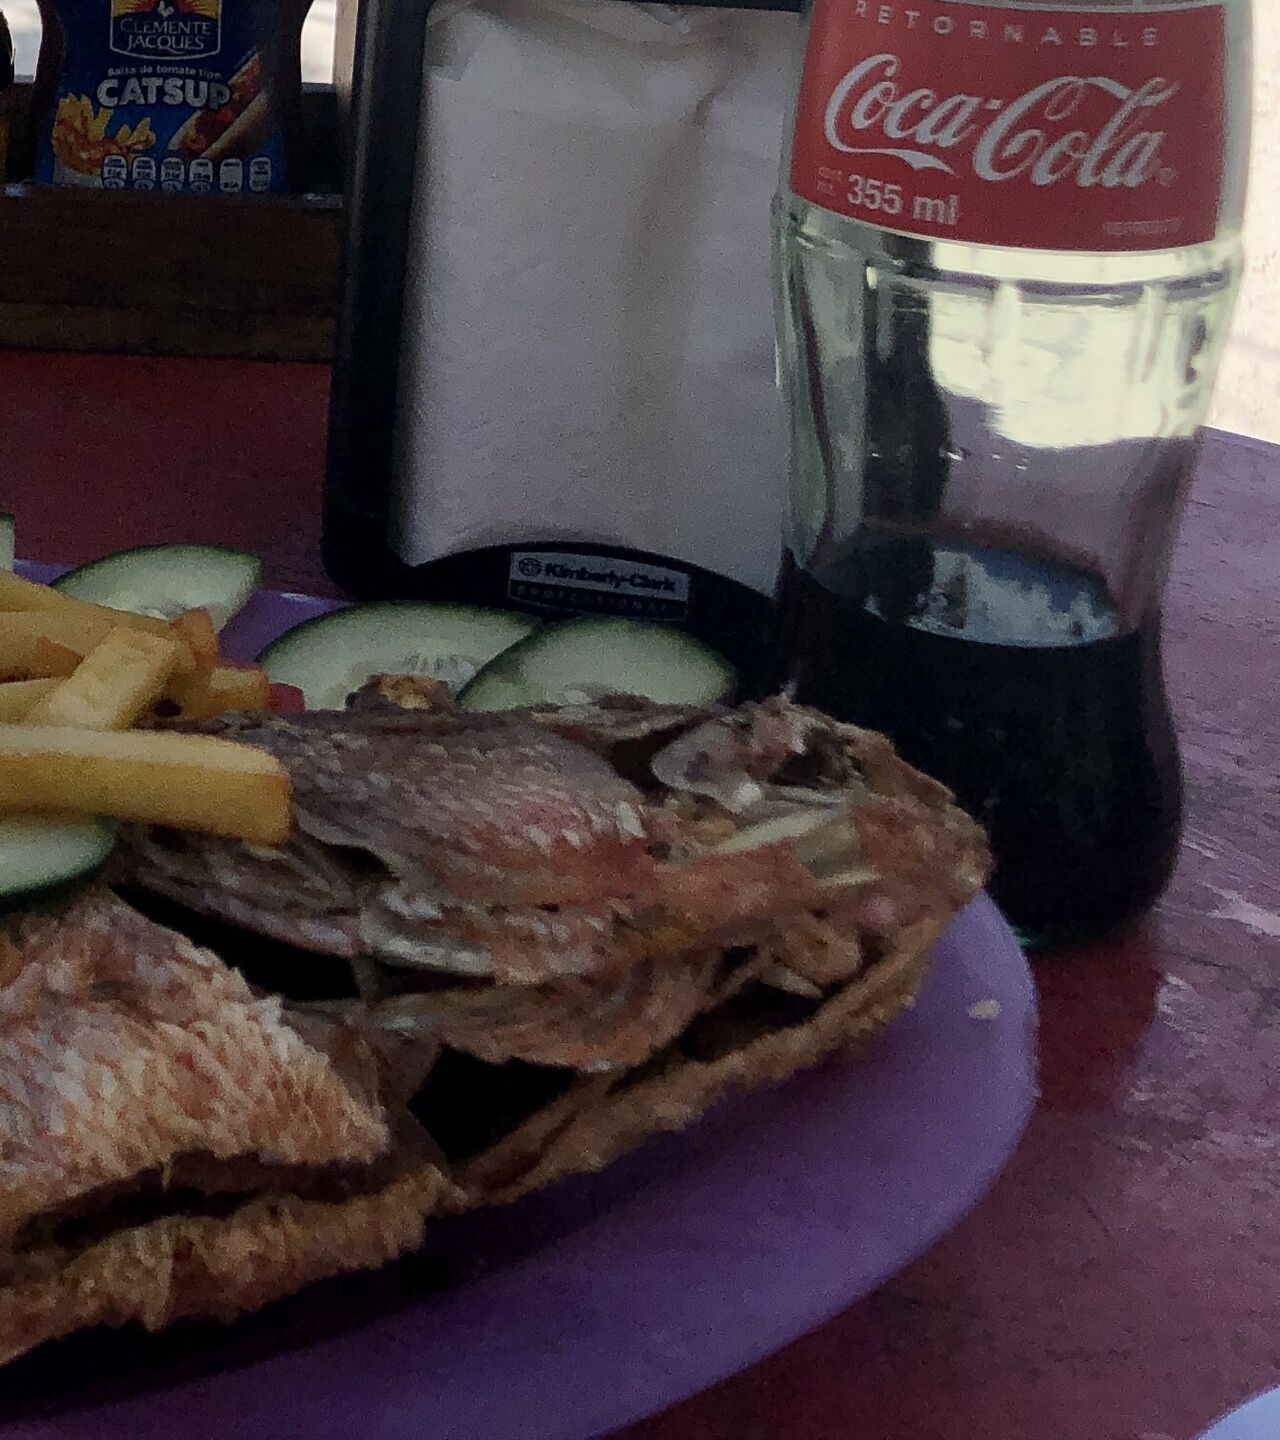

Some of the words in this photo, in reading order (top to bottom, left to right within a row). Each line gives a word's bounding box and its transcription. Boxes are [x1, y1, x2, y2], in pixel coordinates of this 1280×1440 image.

[119, 17, 212, 35] CLEMENTE
[126, 35, 205, 55] JACQUES
[156, 65, 196, 76] tomate
[96, 77, 231, 110] CATSUP
[824, 54, 1182, 189] Coca-Cola
[847, 173, 903, 215] 355
[912, 194, 960, 225] ml
[544, 562, 676, 592] Kimberly-Clark
